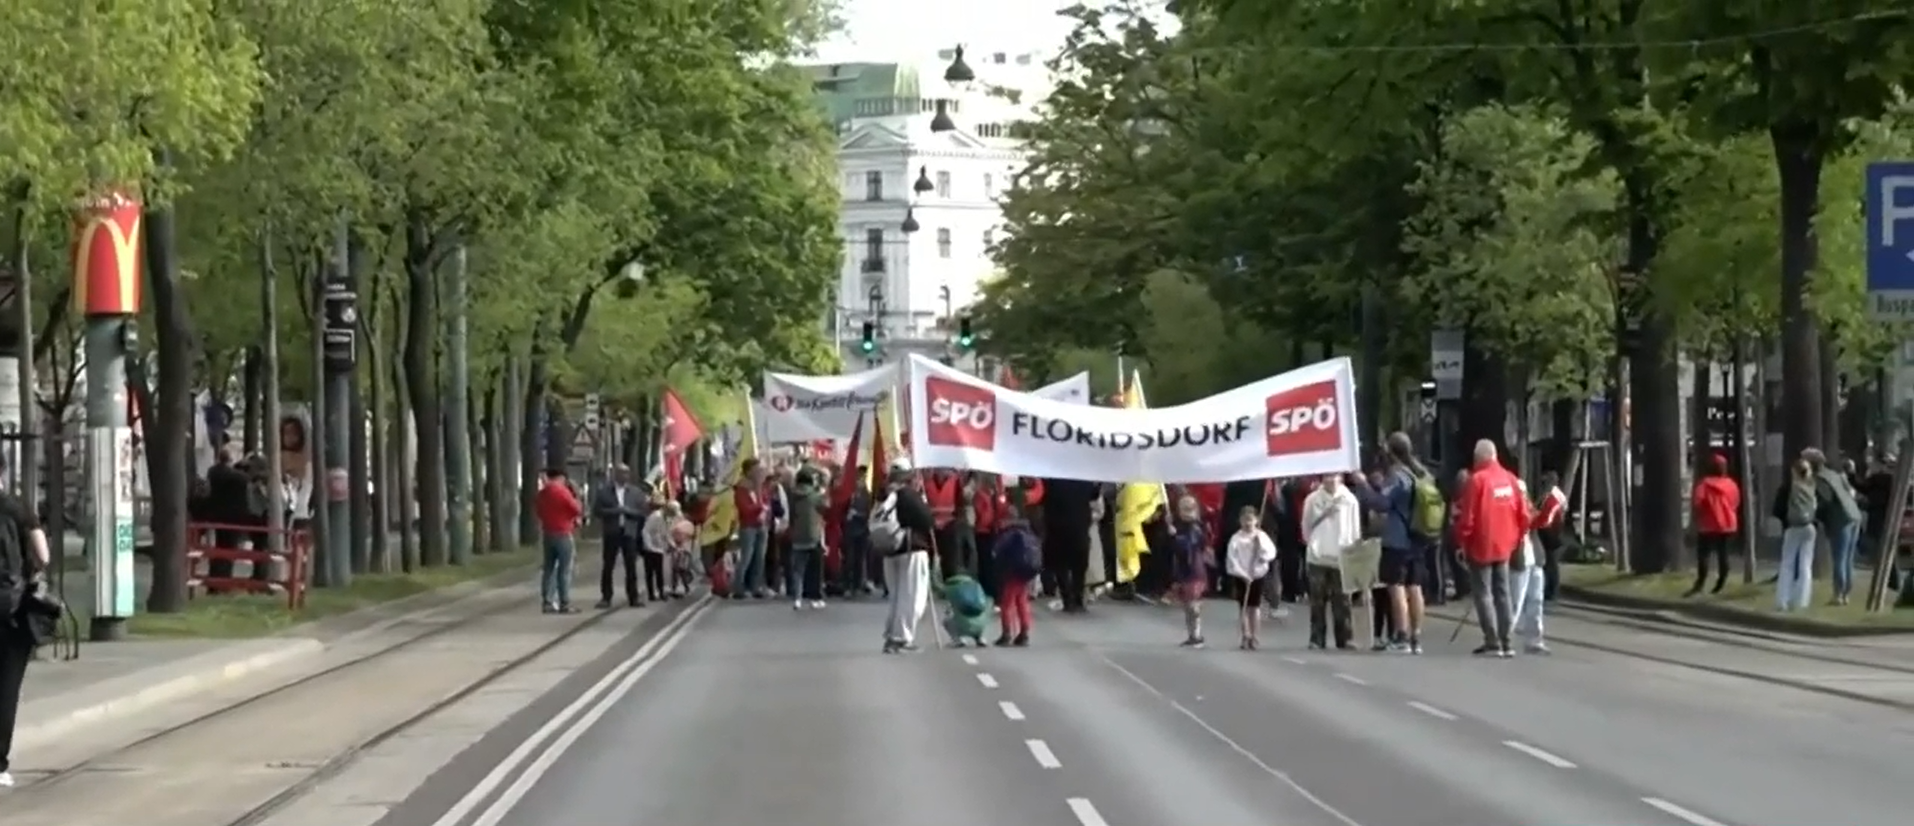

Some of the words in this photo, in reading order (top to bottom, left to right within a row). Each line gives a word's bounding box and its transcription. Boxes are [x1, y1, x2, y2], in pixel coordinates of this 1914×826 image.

[1881, 175, 1914, 246] P
[930, 397, 993, 430] SPÖ
[1012, 411, 1251, 450] FLORIDSDORF
[1269, 396, 1336, 435] SPÖ
